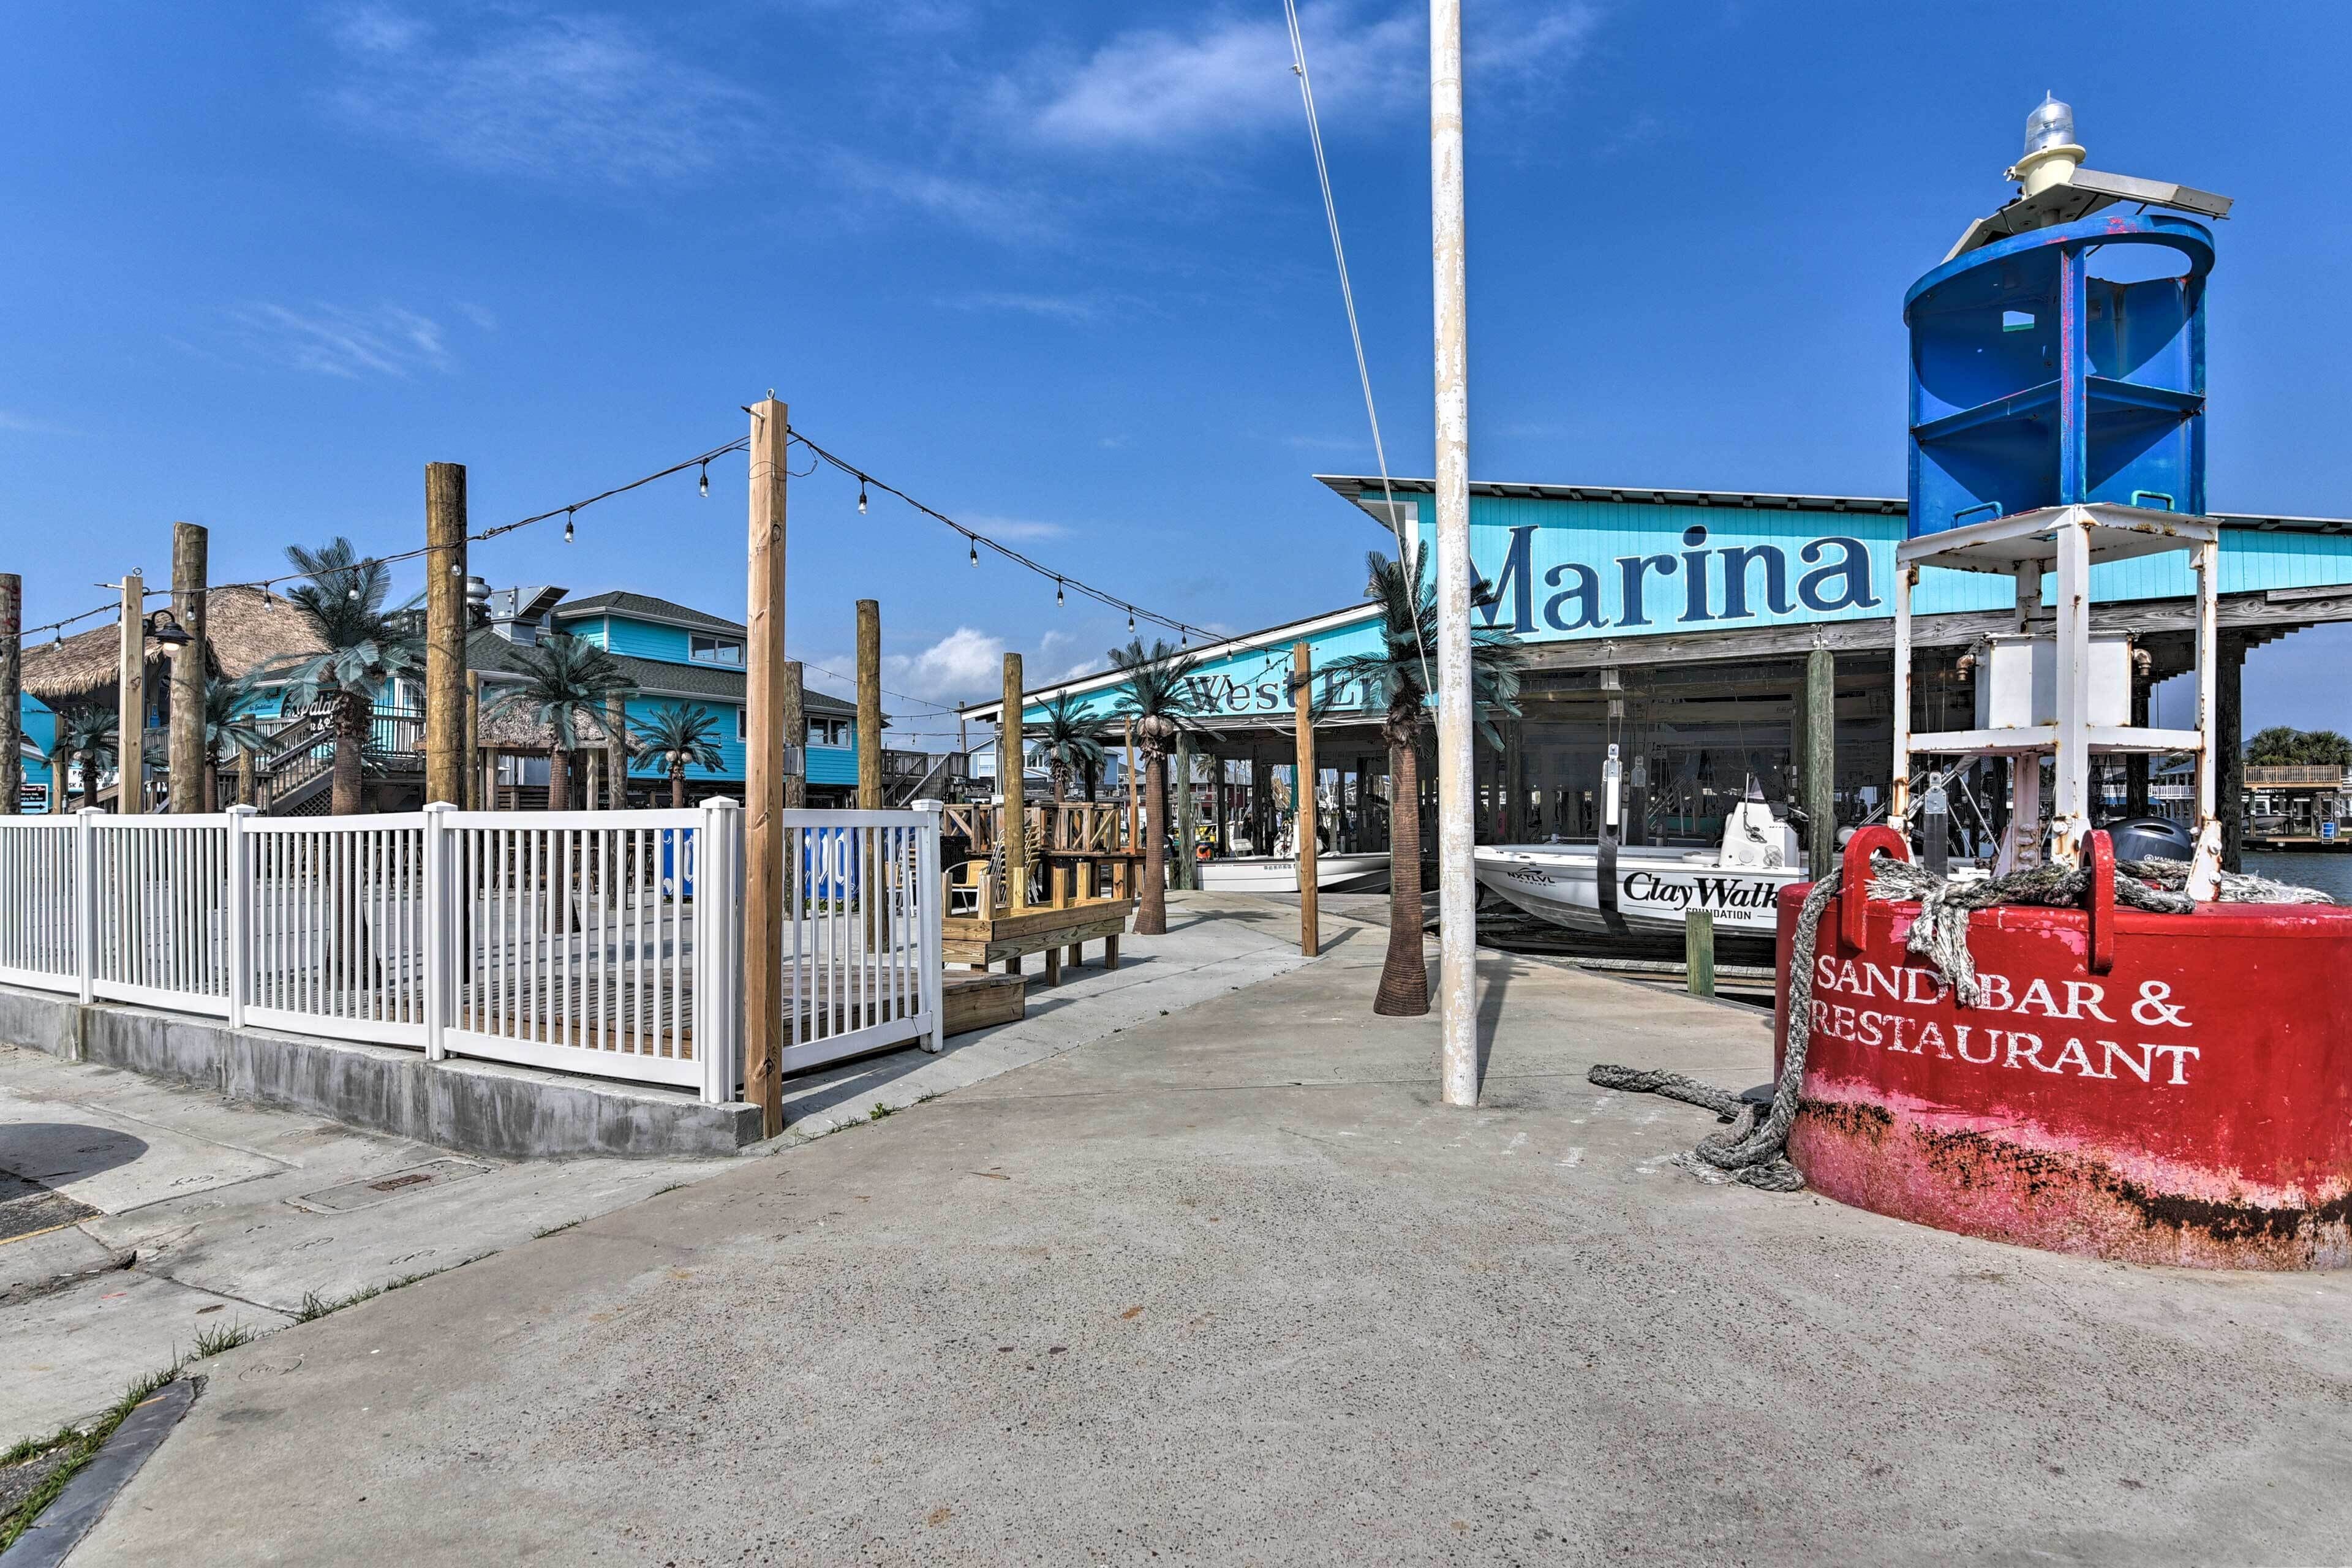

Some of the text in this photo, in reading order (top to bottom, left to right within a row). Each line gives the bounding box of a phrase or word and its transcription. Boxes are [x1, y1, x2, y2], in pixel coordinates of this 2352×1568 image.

[1470, 524, 1883, 635] Marina
[1183, 670, 1297, 712] West
[1507, 872, 1556, 883] NXTLVL
[1817, 954, 2193, 1028] SAND BAR &
[1811, 999, 2201, 1085] RESTAURANT
